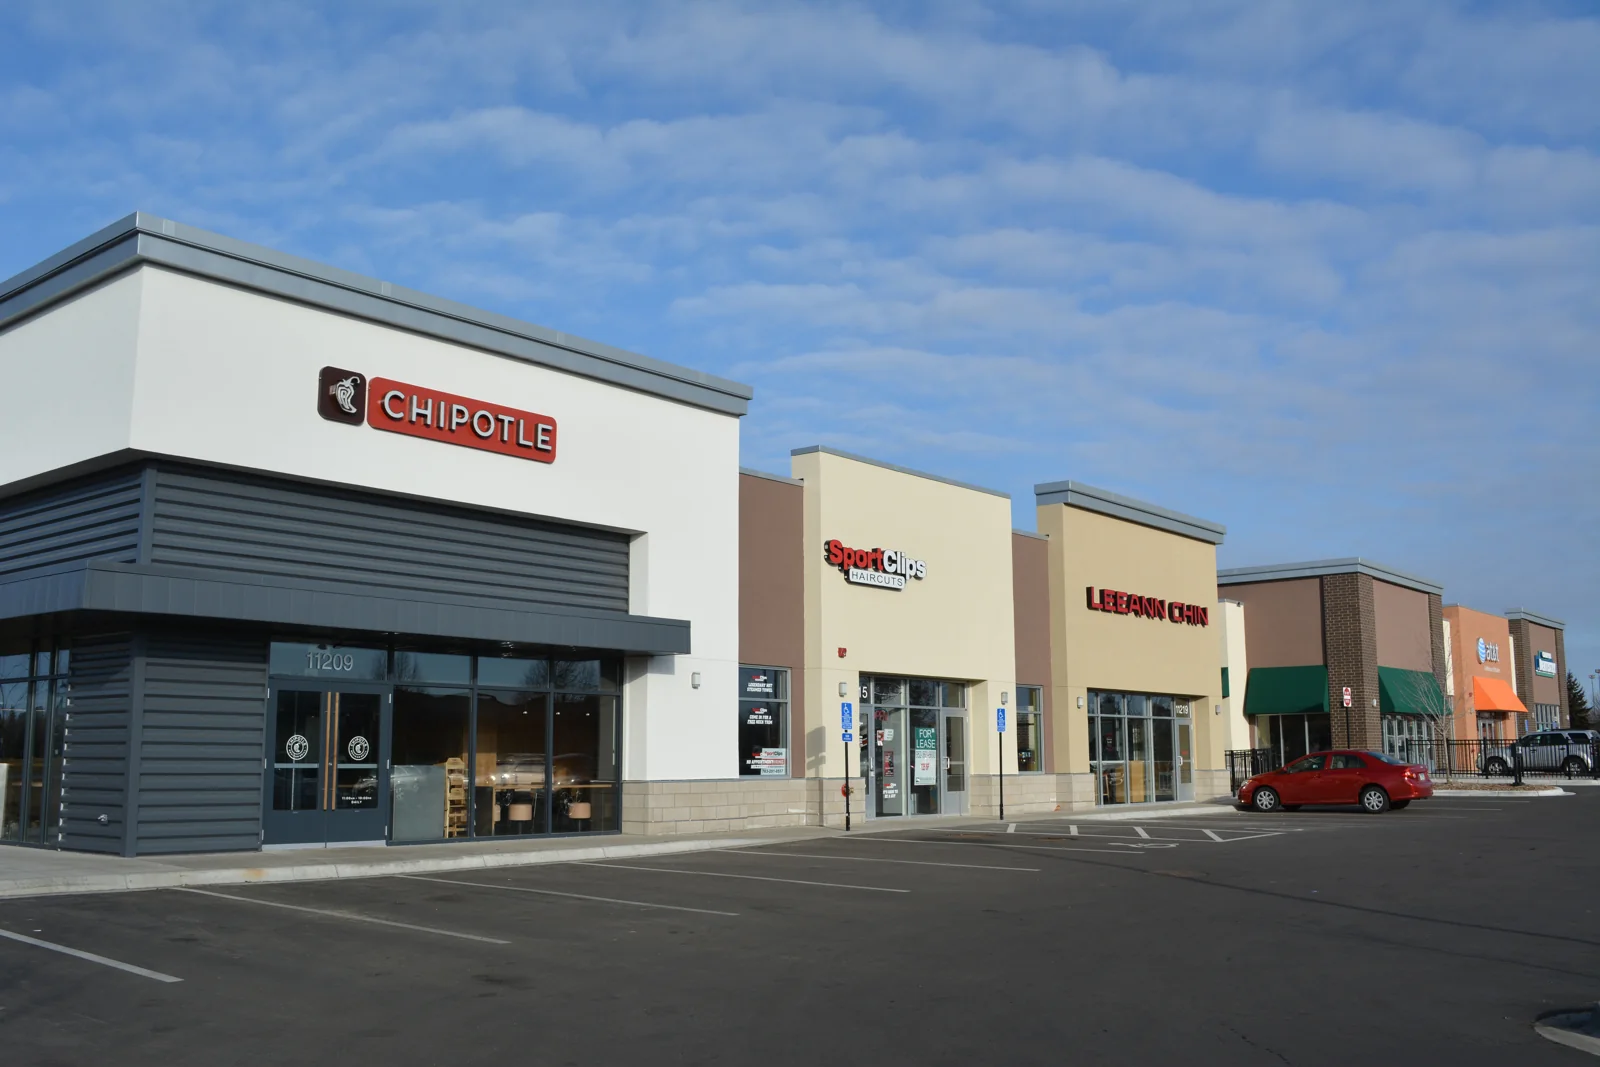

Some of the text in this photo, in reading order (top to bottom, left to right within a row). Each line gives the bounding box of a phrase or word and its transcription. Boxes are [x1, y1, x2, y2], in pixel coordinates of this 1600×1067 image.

[384, 390, 553, 451] CHIPOTLE
[828, 539, 927, 580] SportClips
[851, 571, 903, 587] HAIRCUTS
[1088, 586, 1209, 626] LEEANN CHIN
[307, 651, 354, 671] 11209
[919, 729, 932, 738] FOR
[916, 739, 936, 749] LEASE
